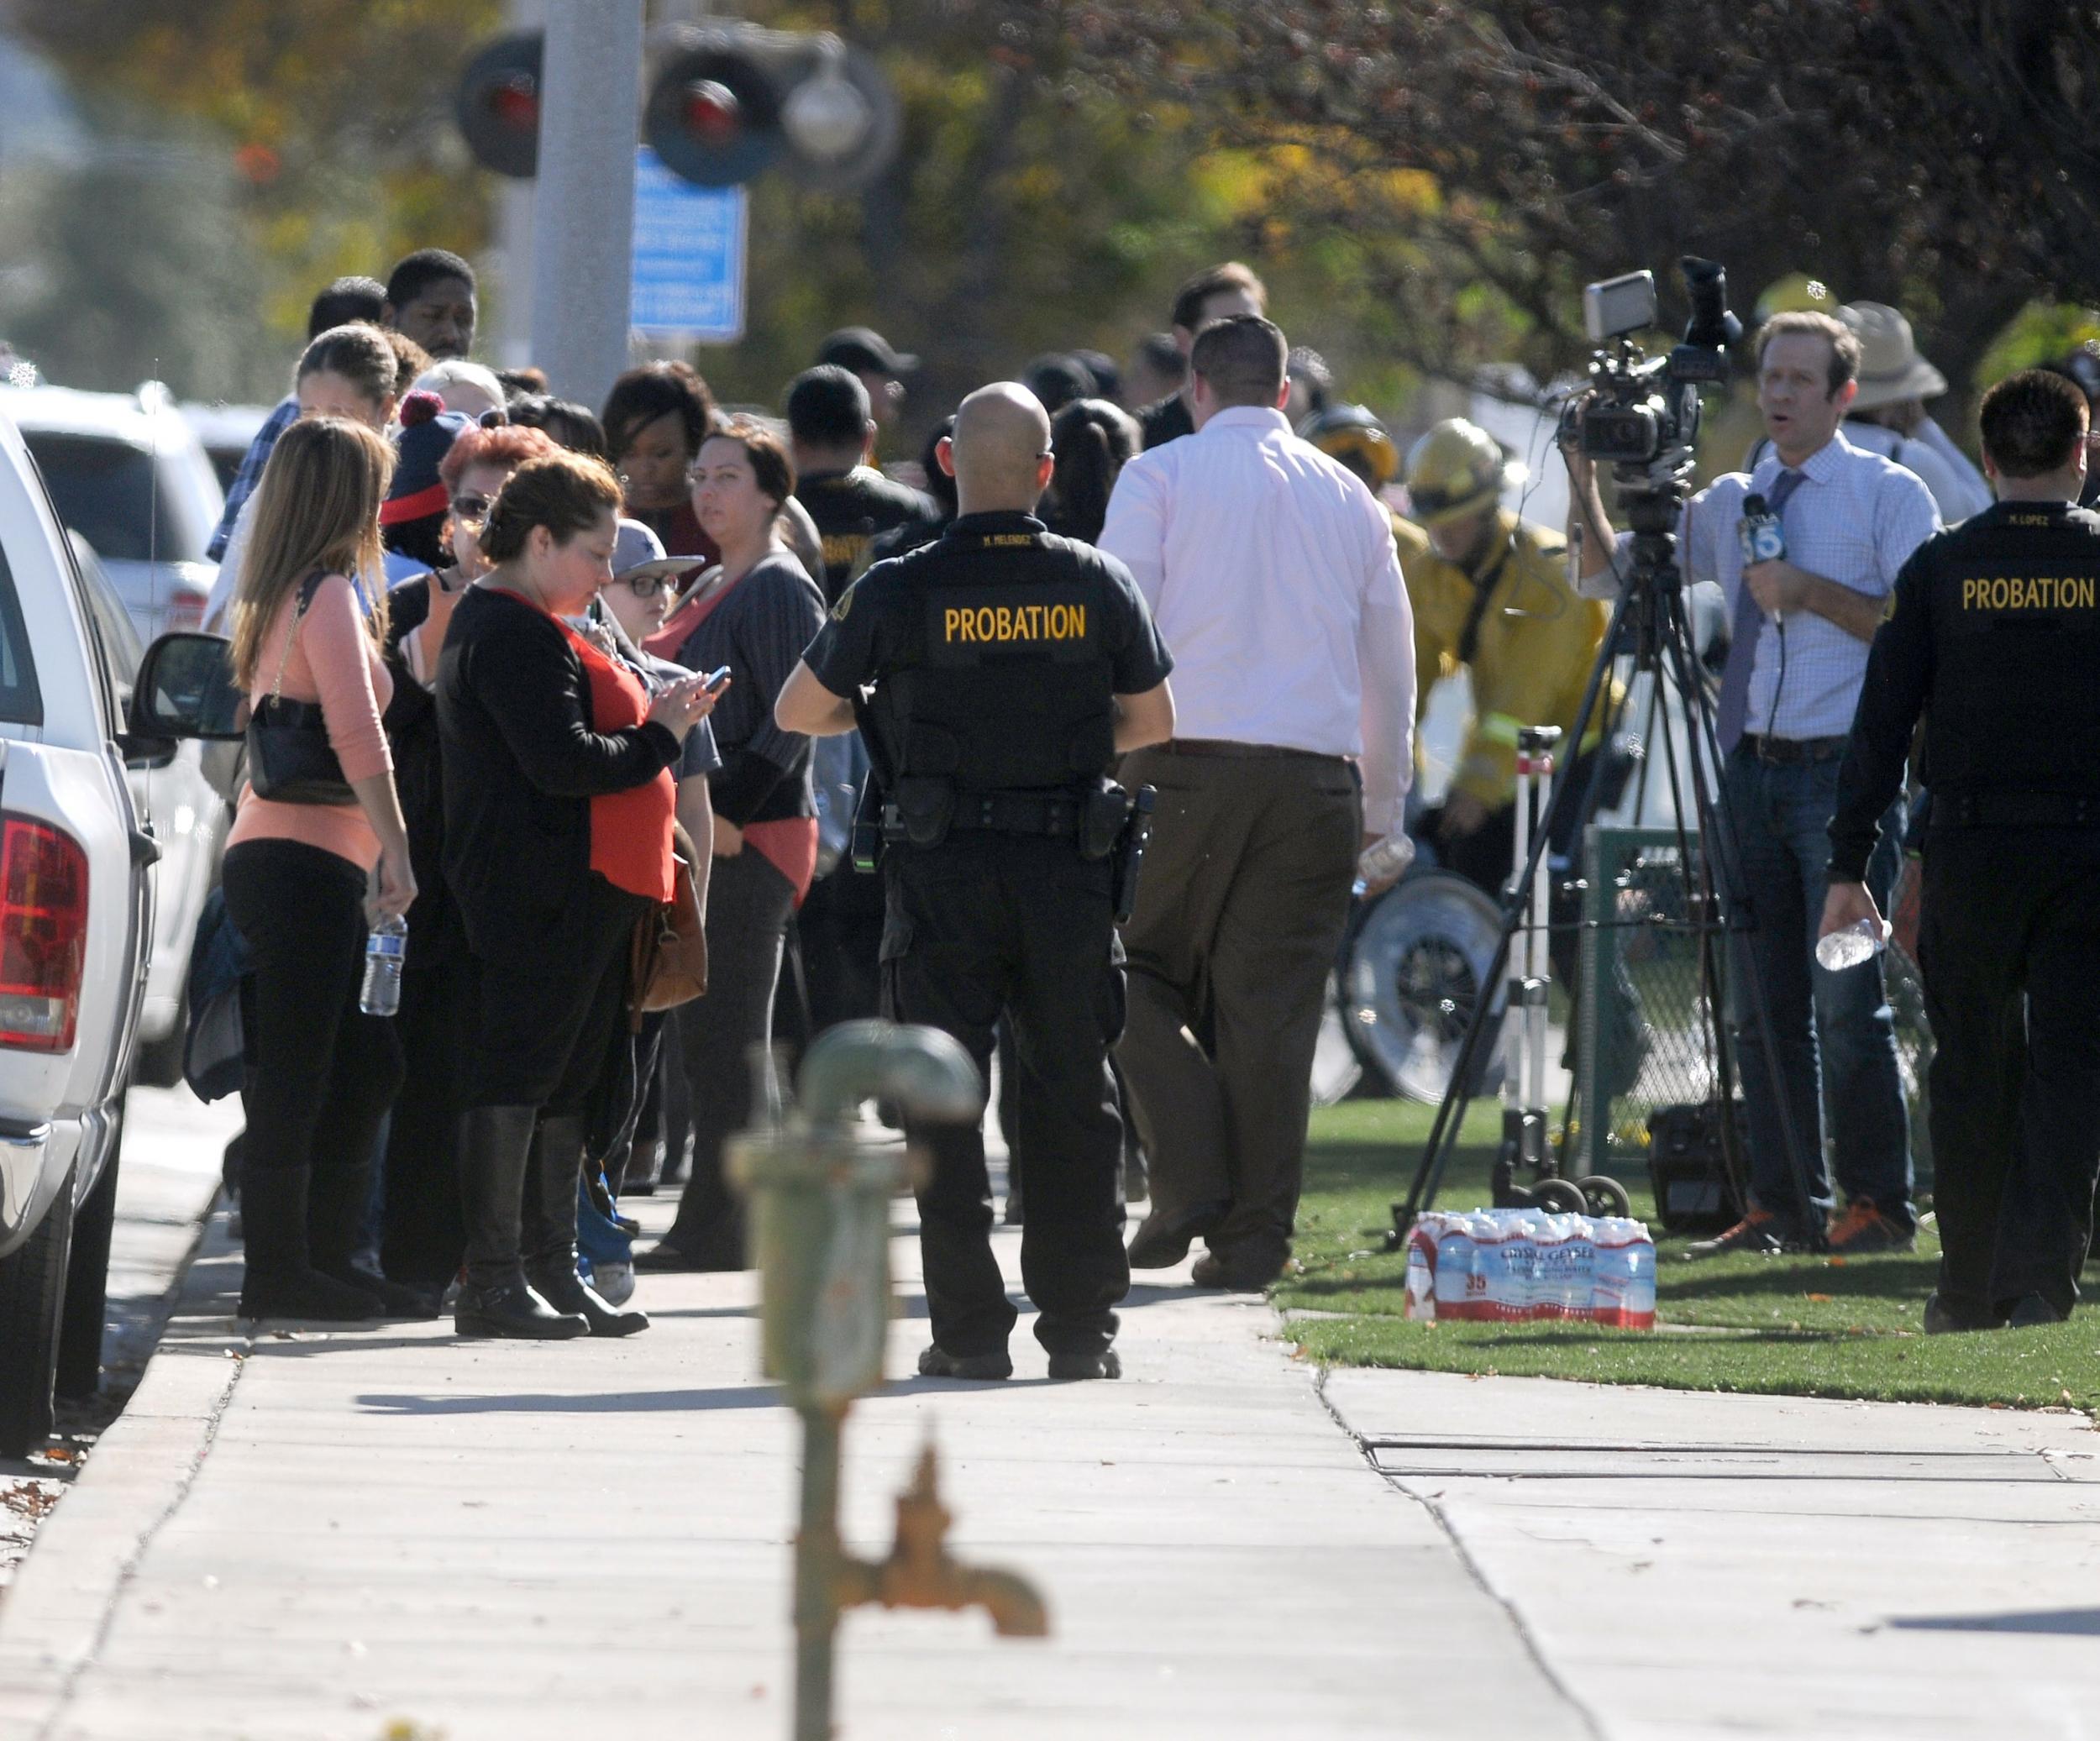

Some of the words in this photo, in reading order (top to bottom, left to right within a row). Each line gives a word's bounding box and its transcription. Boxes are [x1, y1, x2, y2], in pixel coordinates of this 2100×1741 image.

[1756, 526, 1782, 557] 5
[1962, 578, 2095, 611] PROBATION
[945, 604, 1085, 642] PROBATION
[1465, 1272, 1487, 1291] 35
